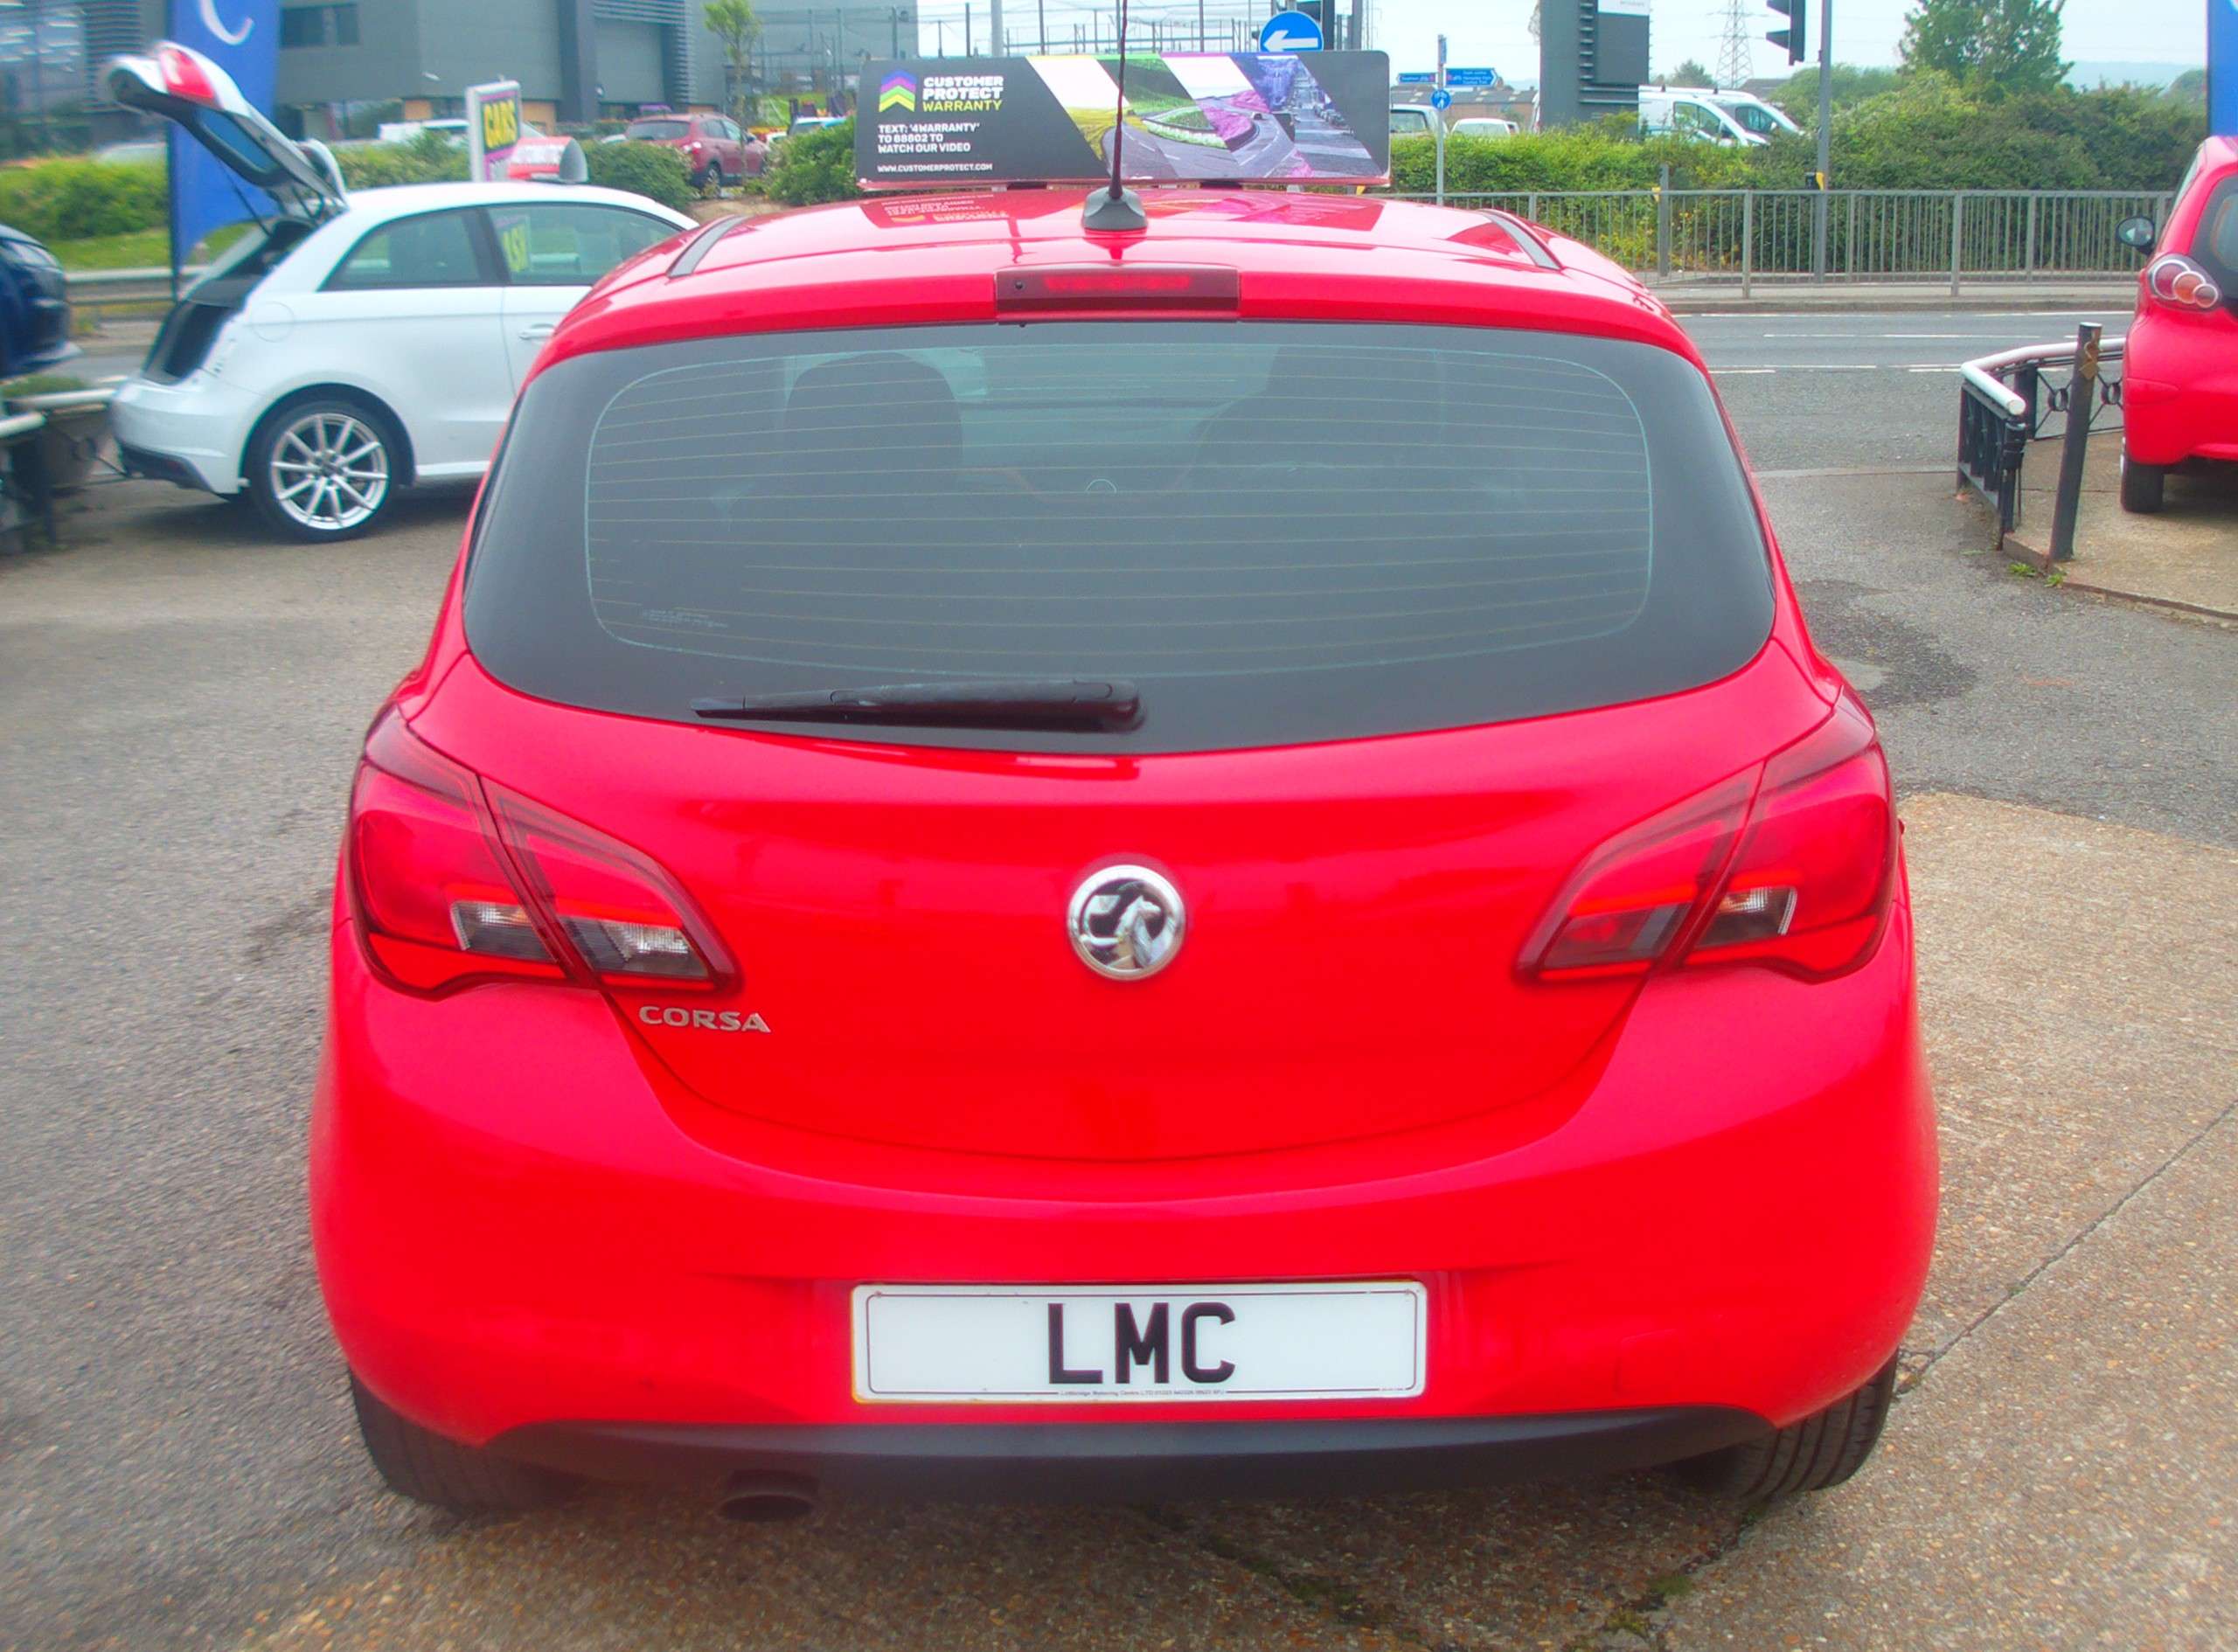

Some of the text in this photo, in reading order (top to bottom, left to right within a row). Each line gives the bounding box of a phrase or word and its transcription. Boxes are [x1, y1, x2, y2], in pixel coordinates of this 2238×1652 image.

[923, 76, 1004, 87] CUSTOMER
[922, 87, 1004, 101] PROTECT
[922, 100, 1003, 112] WARRANTY
[483, 98, 517, 149] CARS
[878, 124, 908, 134] TEXT:
[878, 133, 943, 143] TO 88802 TO
[878, 142, 971, 154] WATCH OUR VIDEO
[877, 163, 993, 173] WWW.CUSTOMERPROTECT.COM
[639, 1005, 772, 1033] CORSA
[1048, 1302, 1235, 1384] LMC
